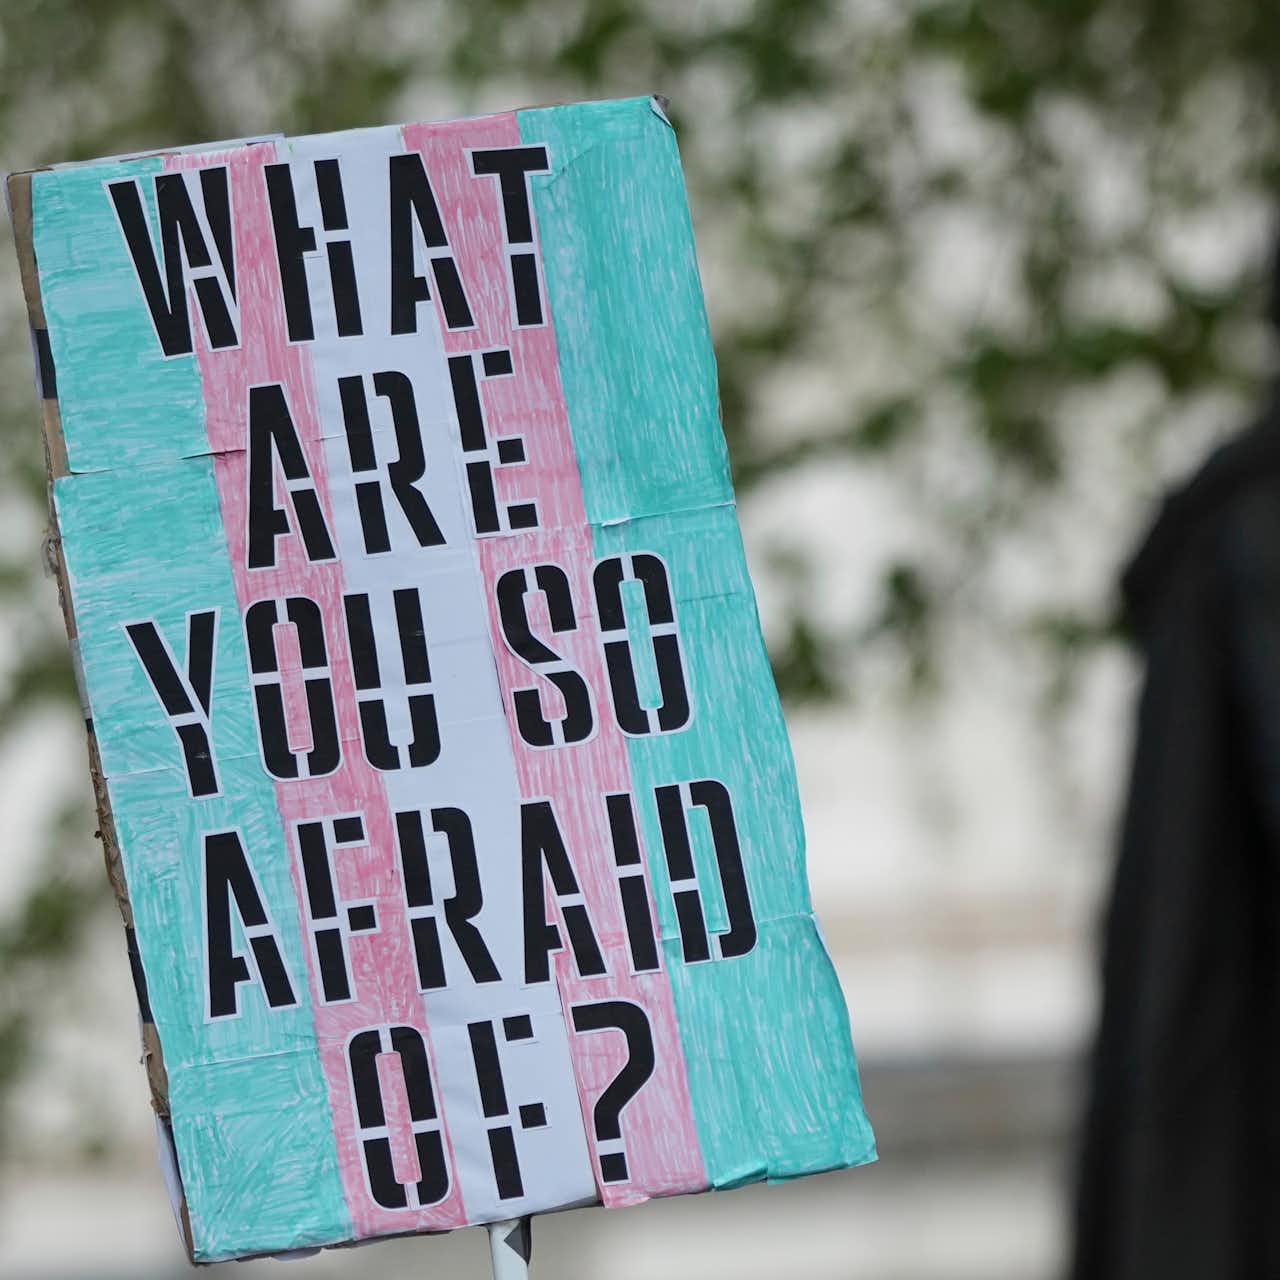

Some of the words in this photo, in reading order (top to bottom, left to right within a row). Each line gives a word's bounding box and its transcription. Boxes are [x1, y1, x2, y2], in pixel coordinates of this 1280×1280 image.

[109, 145, 550, 357] WHAT
[247, 349, 539, 569] ARE
[125, 586, 442, 797] YOU
[495, 553, 693, 747] SO
[204, 780, 757, 1018] AFRAID
[347, 1000, 656, 1209] OF?
